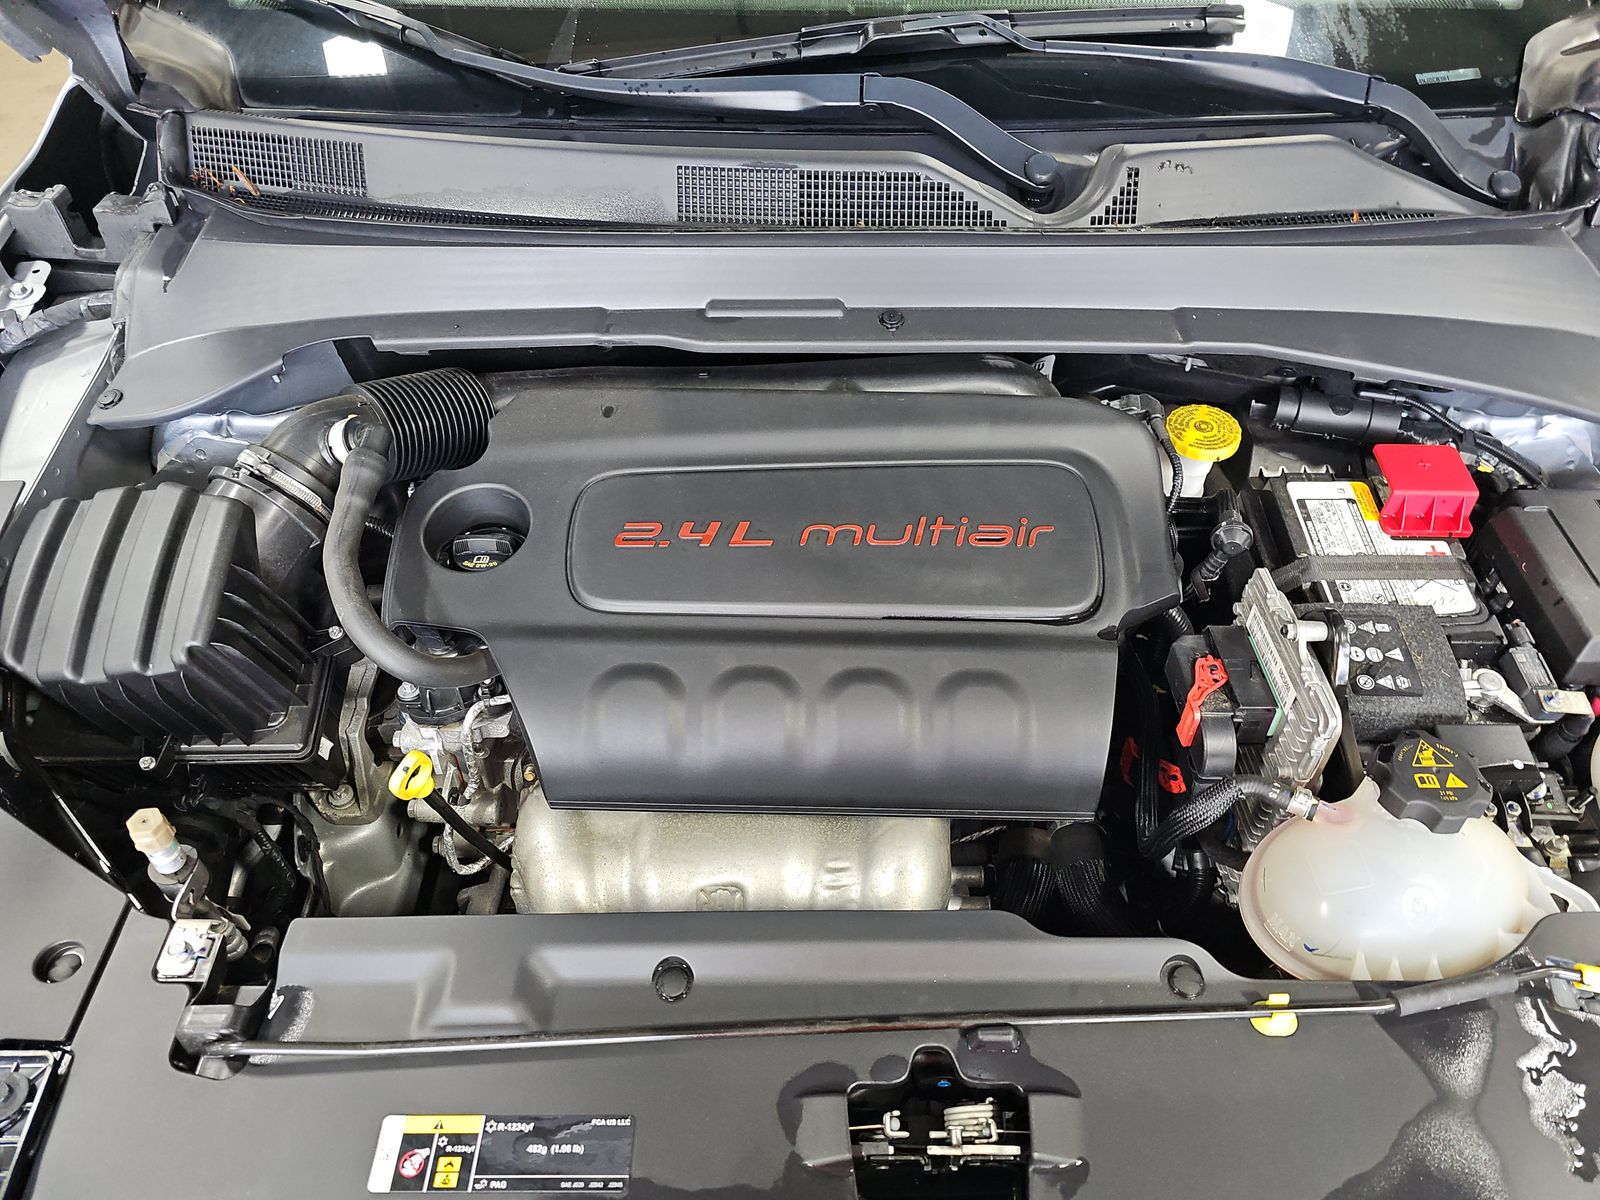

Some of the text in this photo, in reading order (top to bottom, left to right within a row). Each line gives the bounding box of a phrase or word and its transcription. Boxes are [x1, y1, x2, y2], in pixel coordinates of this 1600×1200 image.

[799, 516, 1055, 549] multiair
[462, 560, 475, 568] SAE
[591, 1118, 631, 1126] FCA US LLC
[497, 1122, 535, 1133] R-1234yf
[445, 1145, 476, 1154] R-1234yf
